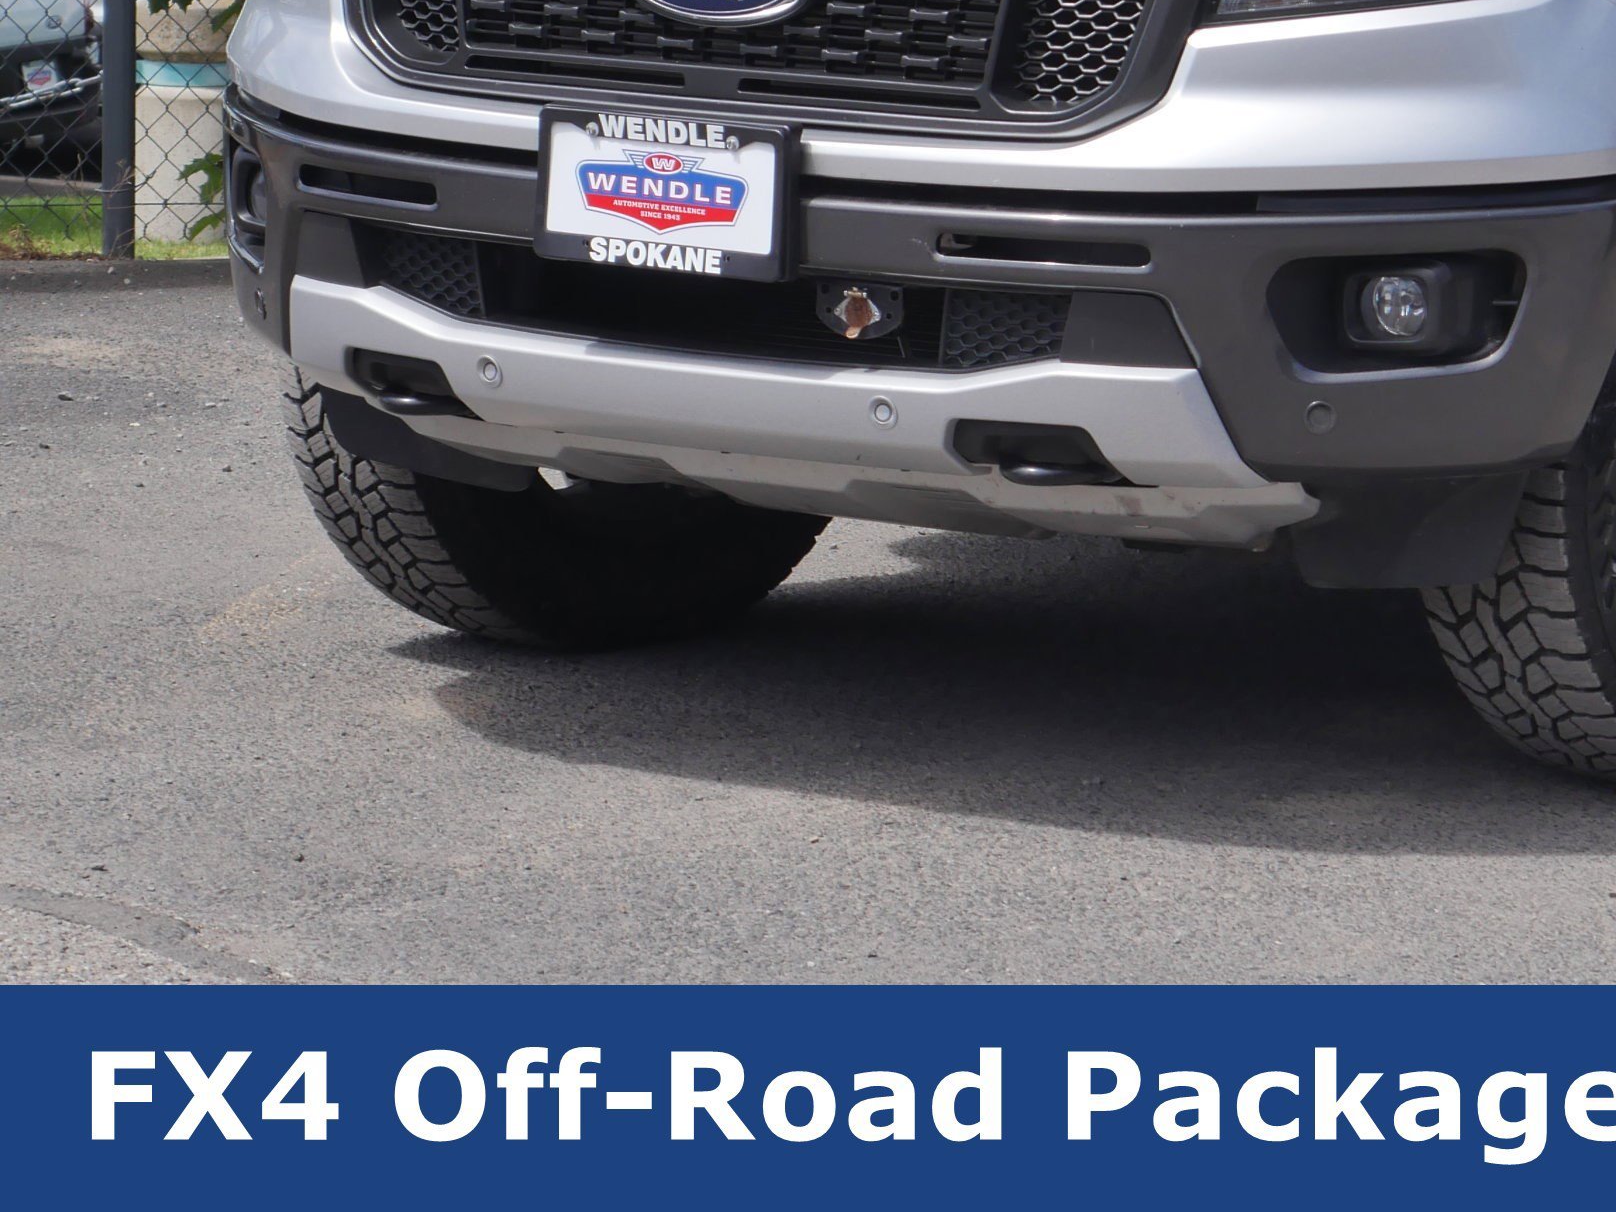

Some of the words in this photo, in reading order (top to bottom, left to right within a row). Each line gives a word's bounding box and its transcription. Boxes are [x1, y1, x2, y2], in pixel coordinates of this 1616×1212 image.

[598, 113, 727, 149] WENDLE
[588, 172, 732, 205] WENDLE
[612, 199, 660, 211] AUTOMOTIVE
[661, 204, 706, 216] EXCELLENCE
[640, 211, 662, 220] SINCE
[664, 213, 681, 221] 1943
[589, 237, 722, 274] SPOKANE
